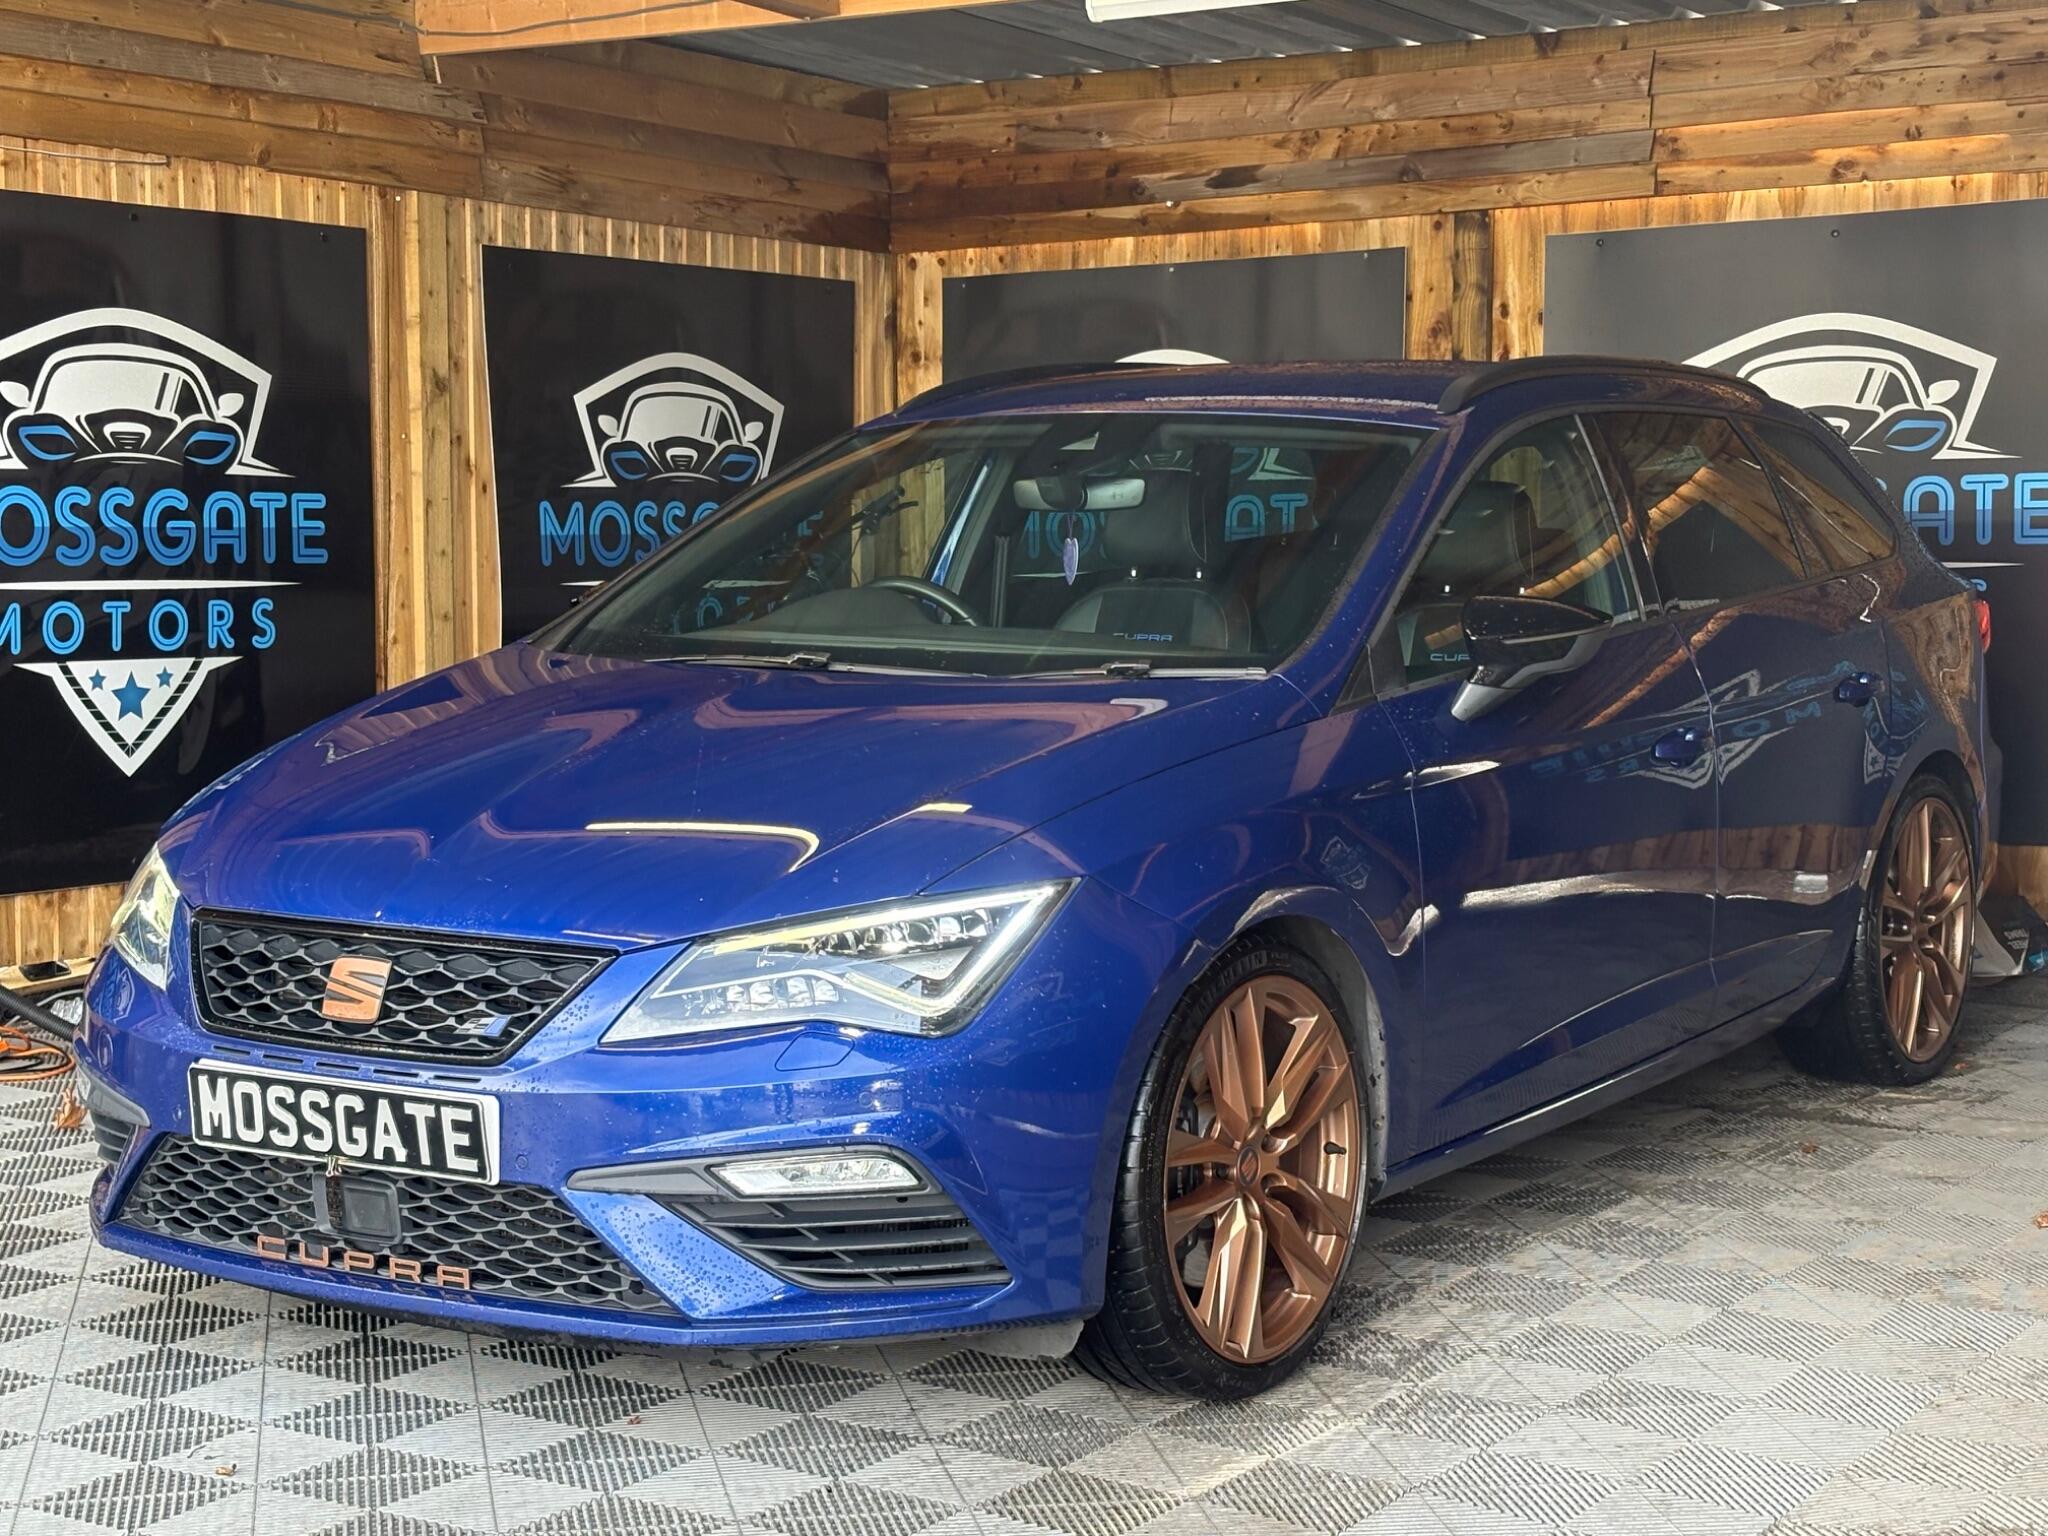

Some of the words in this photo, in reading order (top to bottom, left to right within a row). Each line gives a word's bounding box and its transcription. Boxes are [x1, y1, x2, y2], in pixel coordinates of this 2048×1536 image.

[0, 485, 328, 567] OSSGATE
[538, 500, 721, 567] MOSS
[1903, 473, 2048, 545] ATE
[197, 1074, 480, 1173] MOSSGATE
[256, 1234, 471, 1291] CUPRA
